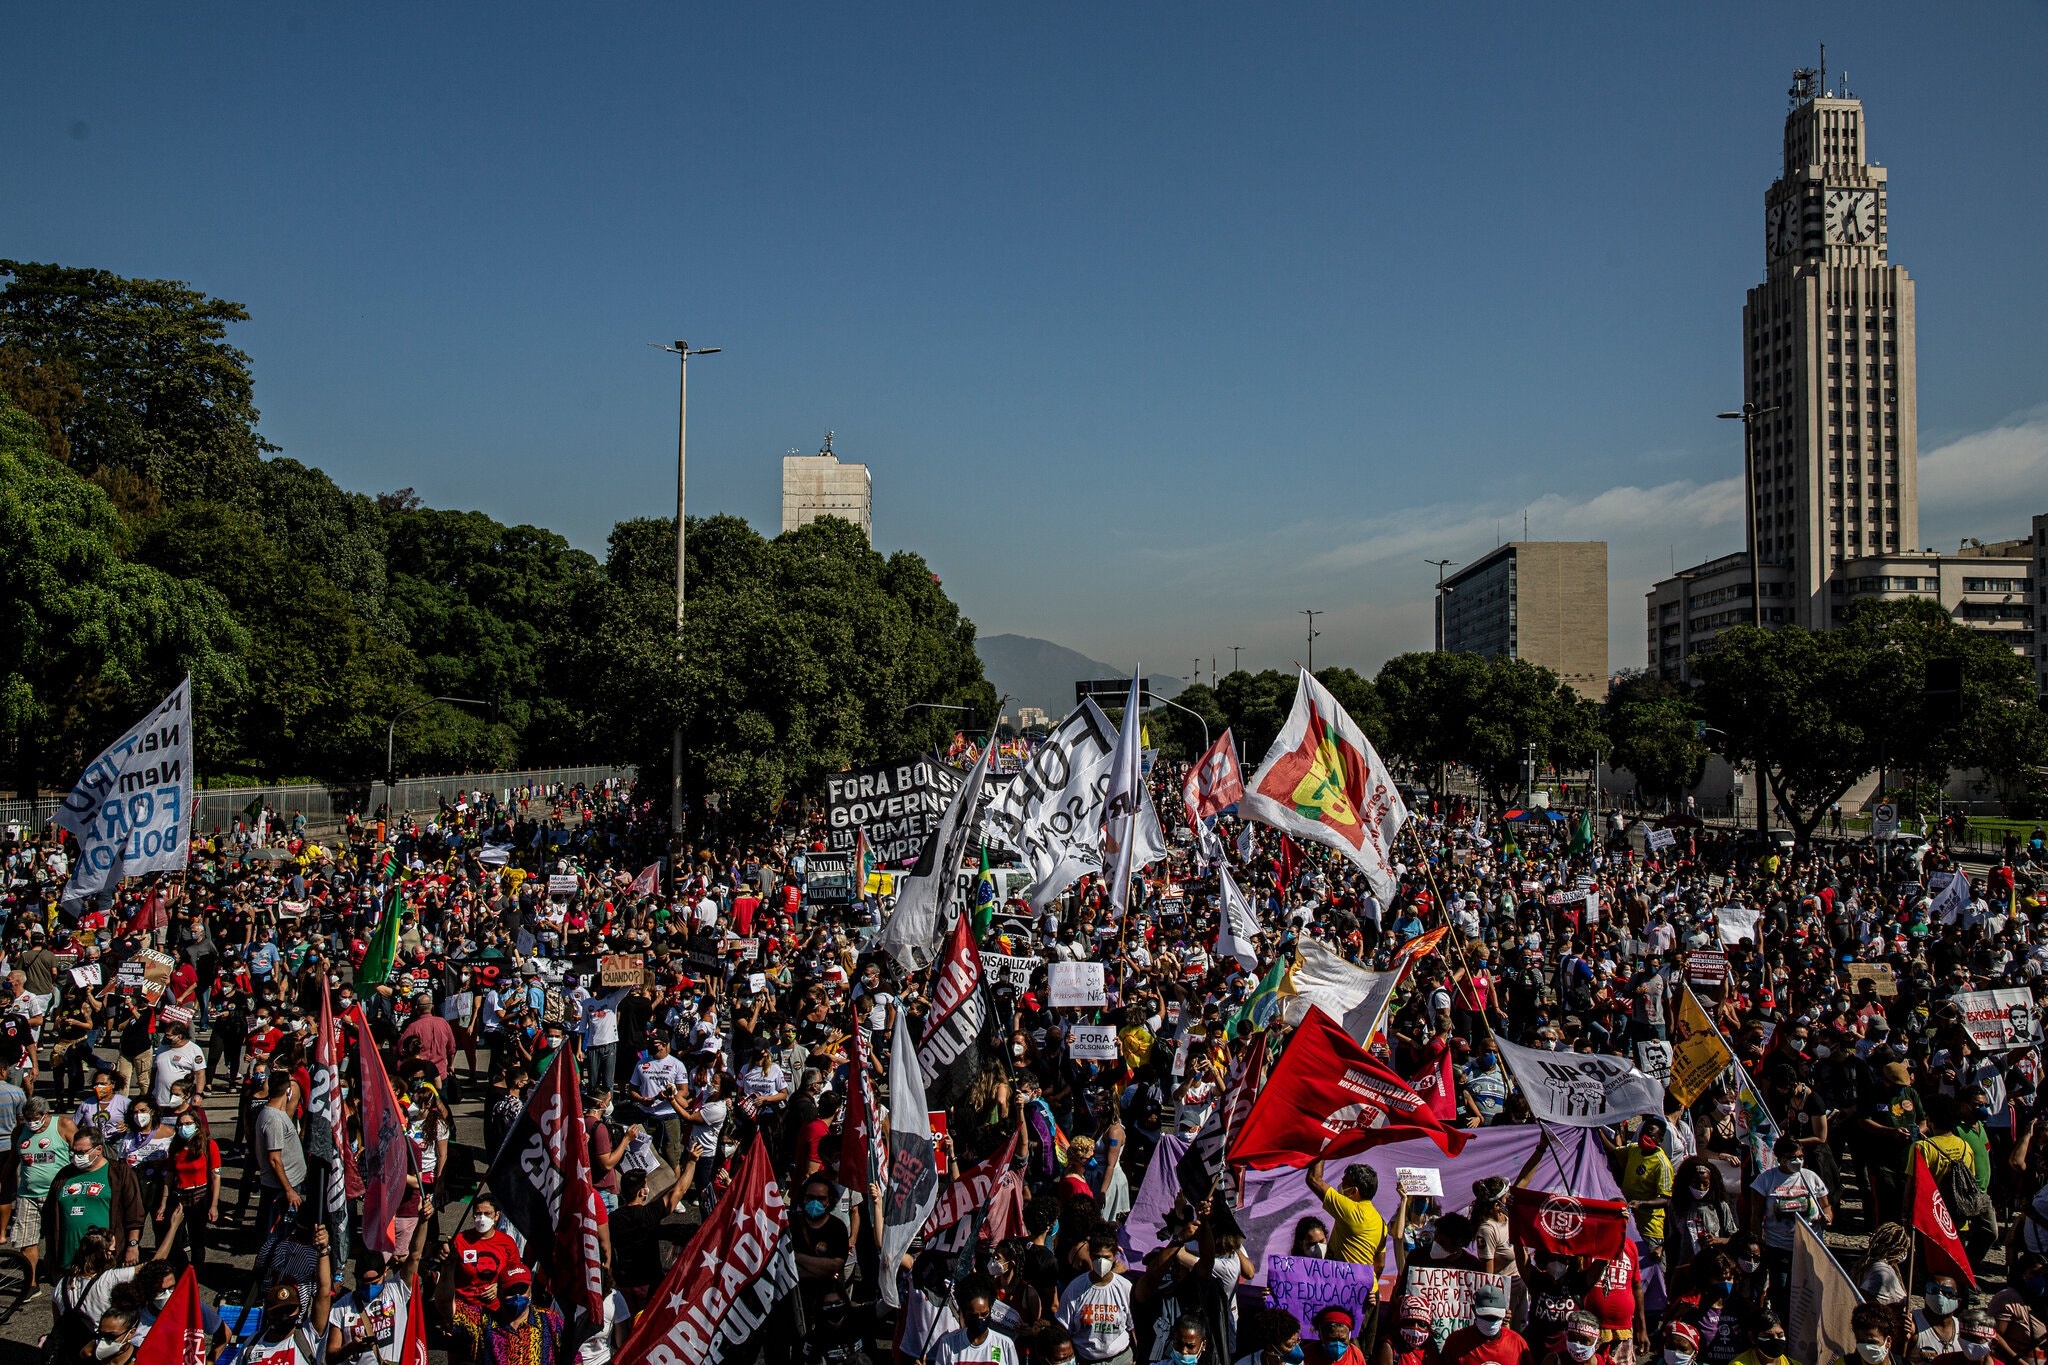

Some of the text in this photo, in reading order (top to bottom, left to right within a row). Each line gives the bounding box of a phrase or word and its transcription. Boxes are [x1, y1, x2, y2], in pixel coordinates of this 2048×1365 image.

[828, 770, 891, 804] FORA
[603, 970, 641, 985] QUANDO?
[1087, 988, 1104, 1002] NÃO
[1080, 1033, 1110, 1044] FORA
[1074, 1043, 1114, 1051] BOLSONARO
[1536, 1060, 1583, 1081] UP
[1337, 1080, 1351, 1089] NOS
[1344, 1068, 1426, 1106] MOVIMENTO DE LUTA
[1272, 1256, 1356, 1281] POR VACINA
[1411, 1269, 1505, 1294] IVERMECTINA
[1268, 1279, 1369, 1307] POR EDUCAÇÃO
[1420, 1287, 1449, 1301] SERVE
[1094, 1304, 1119, 1313] PETRO
[1094, 1313, 1115, 1322] BRAS
[1094, 1323, 1112, 1332] FICA
